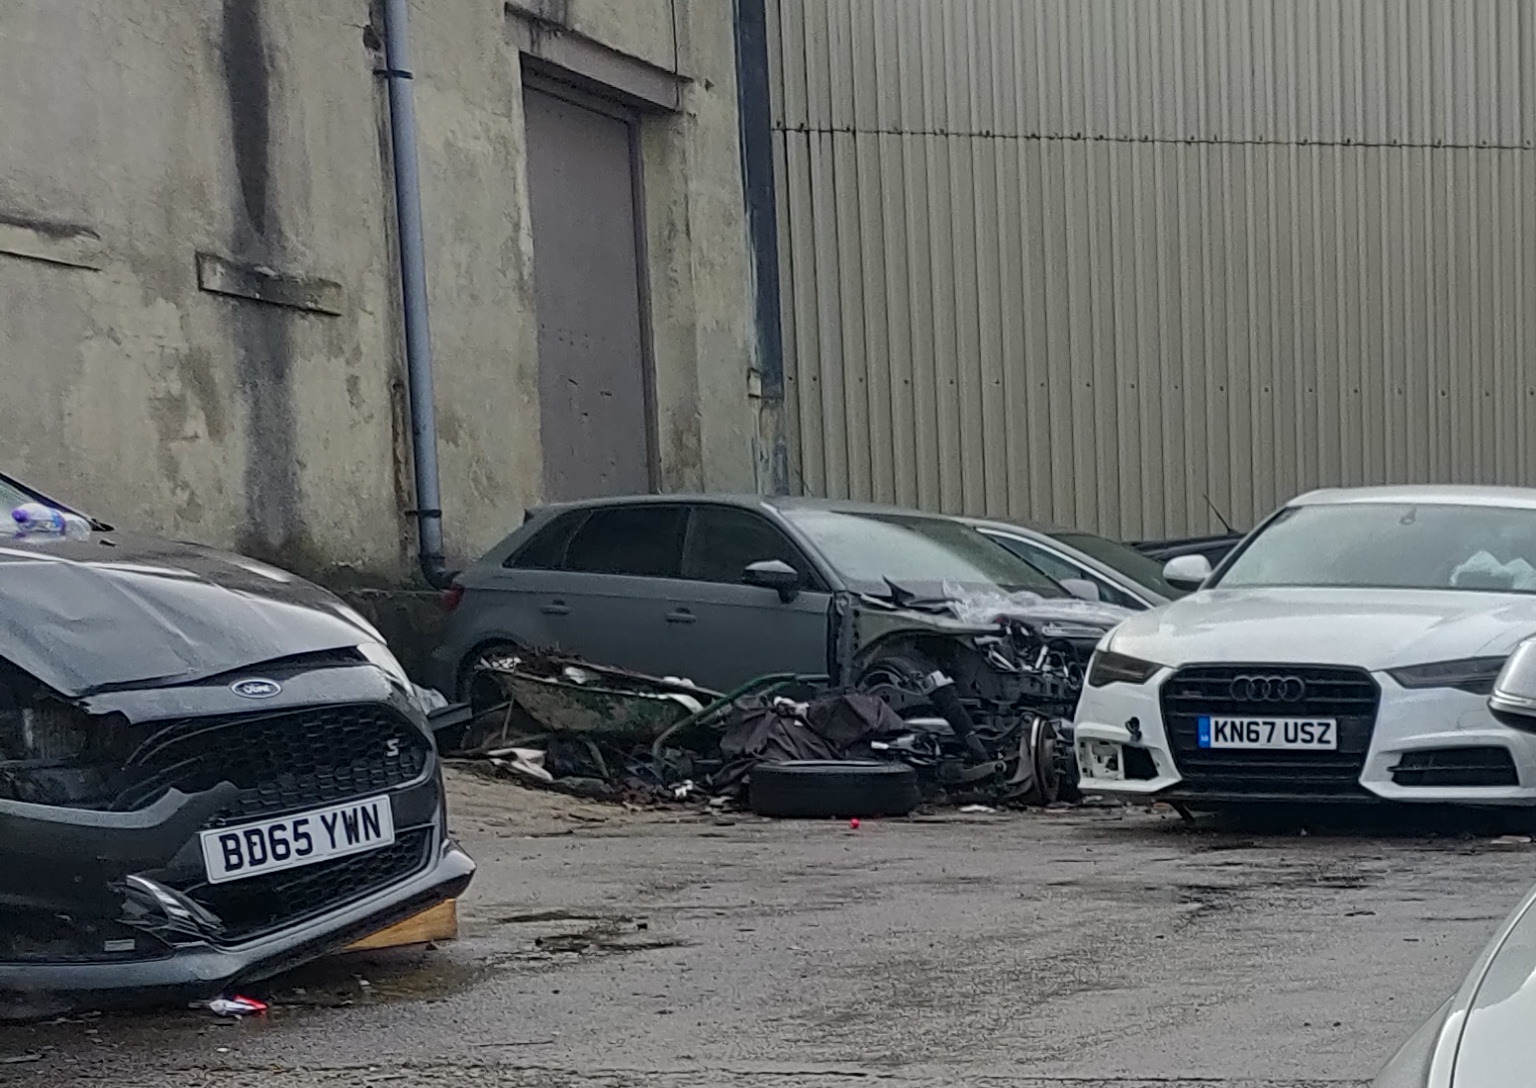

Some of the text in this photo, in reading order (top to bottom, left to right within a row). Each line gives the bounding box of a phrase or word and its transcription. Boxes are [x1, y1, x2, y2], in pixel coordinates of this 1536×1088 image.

[1214, 720, 1332, 745] KN67 USZ
[219, 803, 382, 873] BD65 YWN
